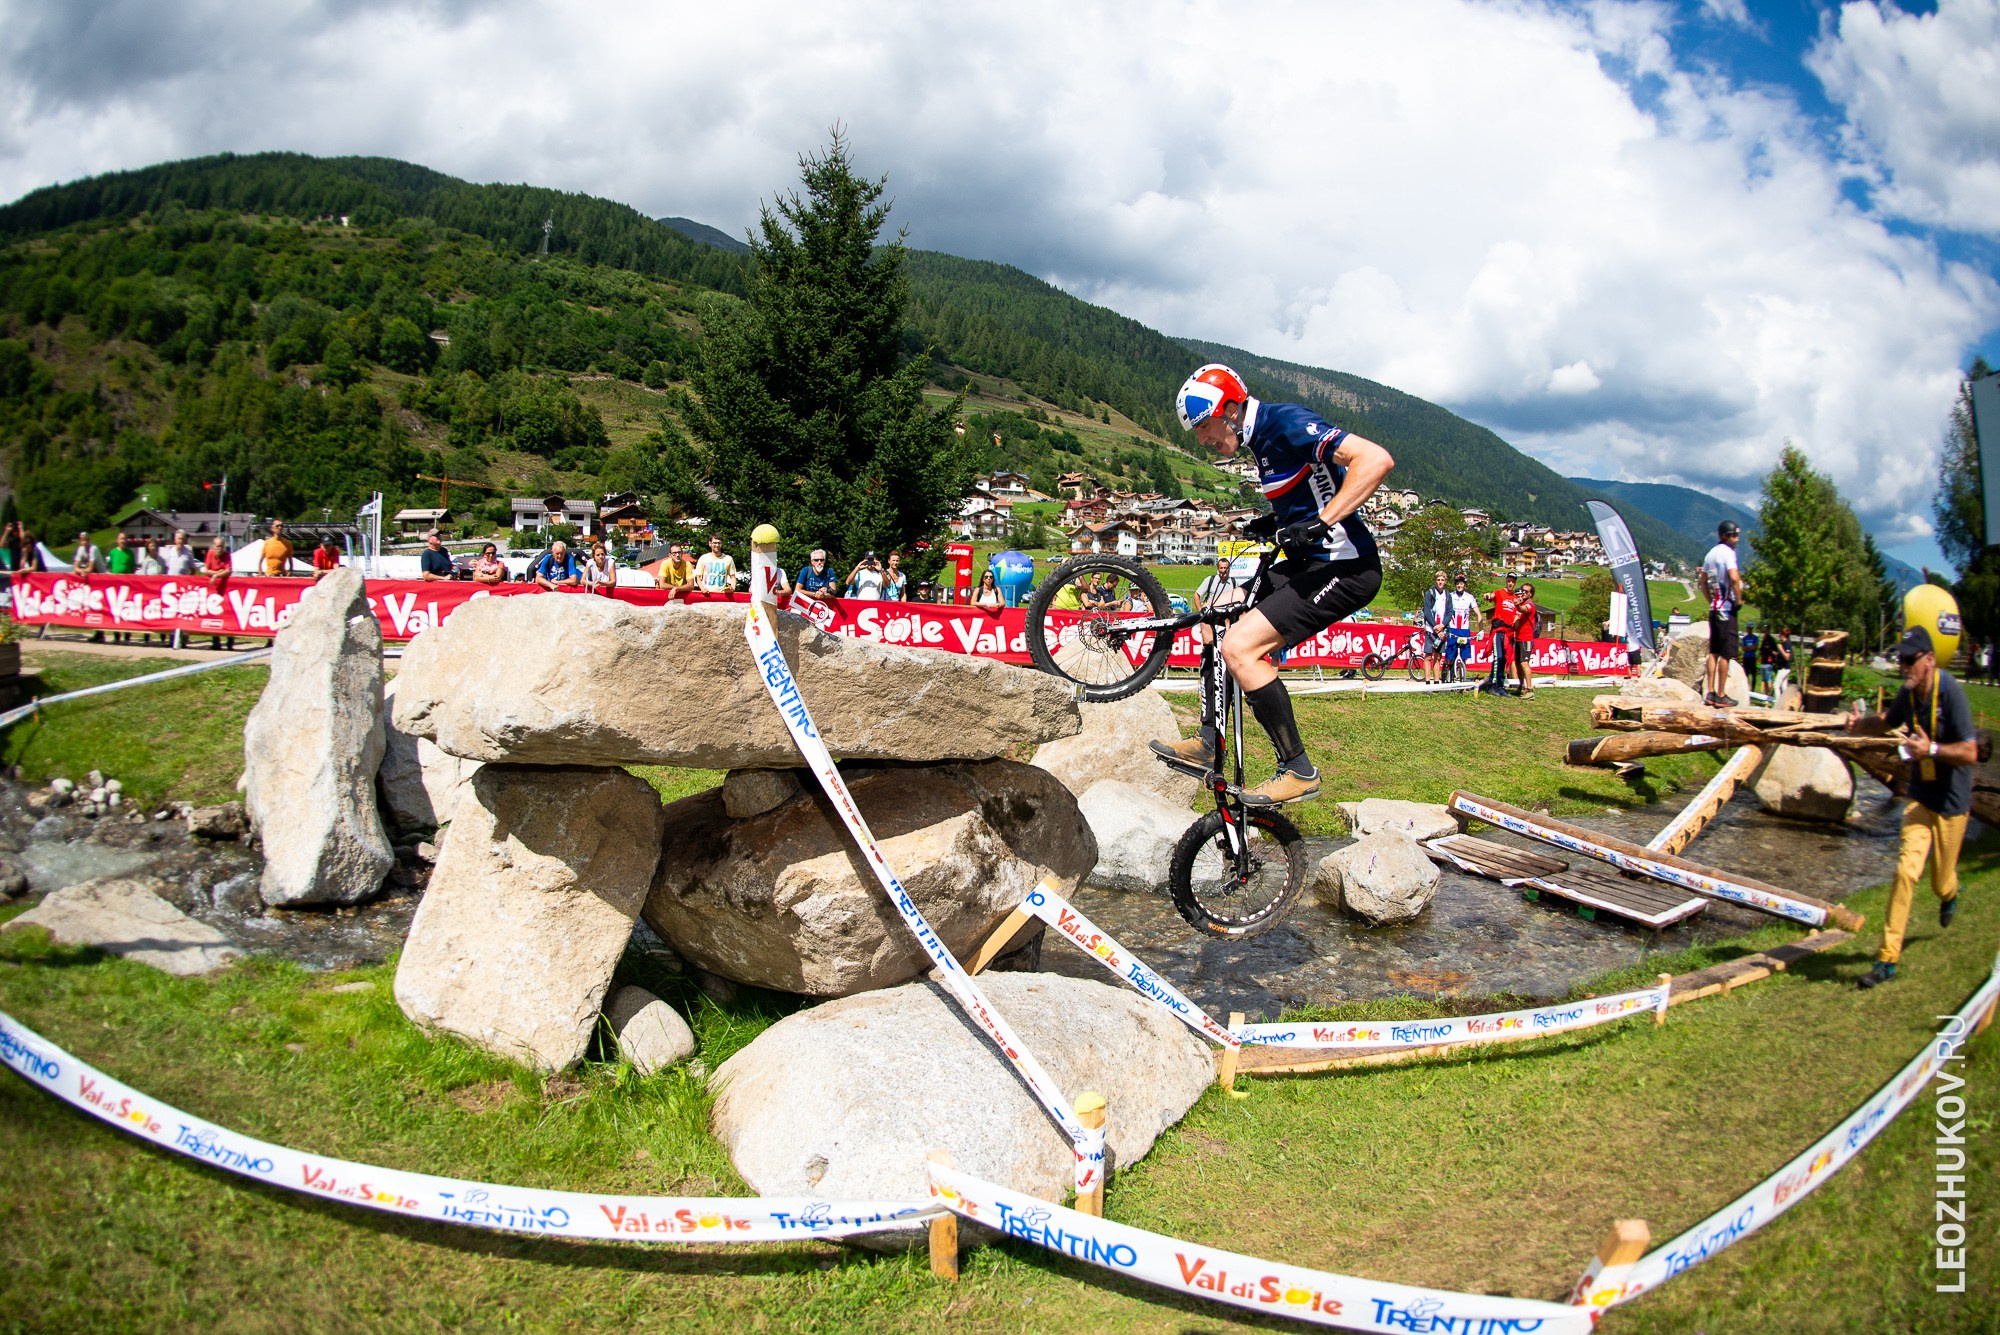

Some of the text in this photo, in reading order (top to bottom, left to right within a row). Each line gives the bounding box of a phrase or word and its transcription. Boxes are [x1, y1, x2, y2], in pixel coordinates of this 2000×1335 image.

[12, 583, 41, 619] Val
[106, 581, 225, 624] Val di Sole
[228, 588, 280, 630] Val
[382, 593, 440, 636] Val
[857, 607, 944, 646] Sole
[949, 616, 1007, 655] Val
[1299, 639, 1316, 657] di
[1315, 628, 1364, 658] Sole
[1580, 648, 1600, 672] Val
[1057, 908, 1121, 968] Val di Sole
[1127, 963, 1190, 1015] TRENTINO
[1313, 1027, 1380, 1042] Val di Sole
[1391, 1024, 1452, 1043] TRENTINO
[1467, 1017, 1523, 1034] Val di Sole
[1533, 1008, 1583, 1028] TRENTINO
[79, 1074, 162, 1135] Val di Sole
[174, 1124, 274, 1173] TRENTINO
[301, 1163, 337, 1191] Val
[356, 1182, 420, 1211] Sole
[599, 1204, 753, 1235] Val di Sole
[995, 1201, 1138, 1268] TRENTINO
[1175, 1252, 1344, 1317] Val di Sole
